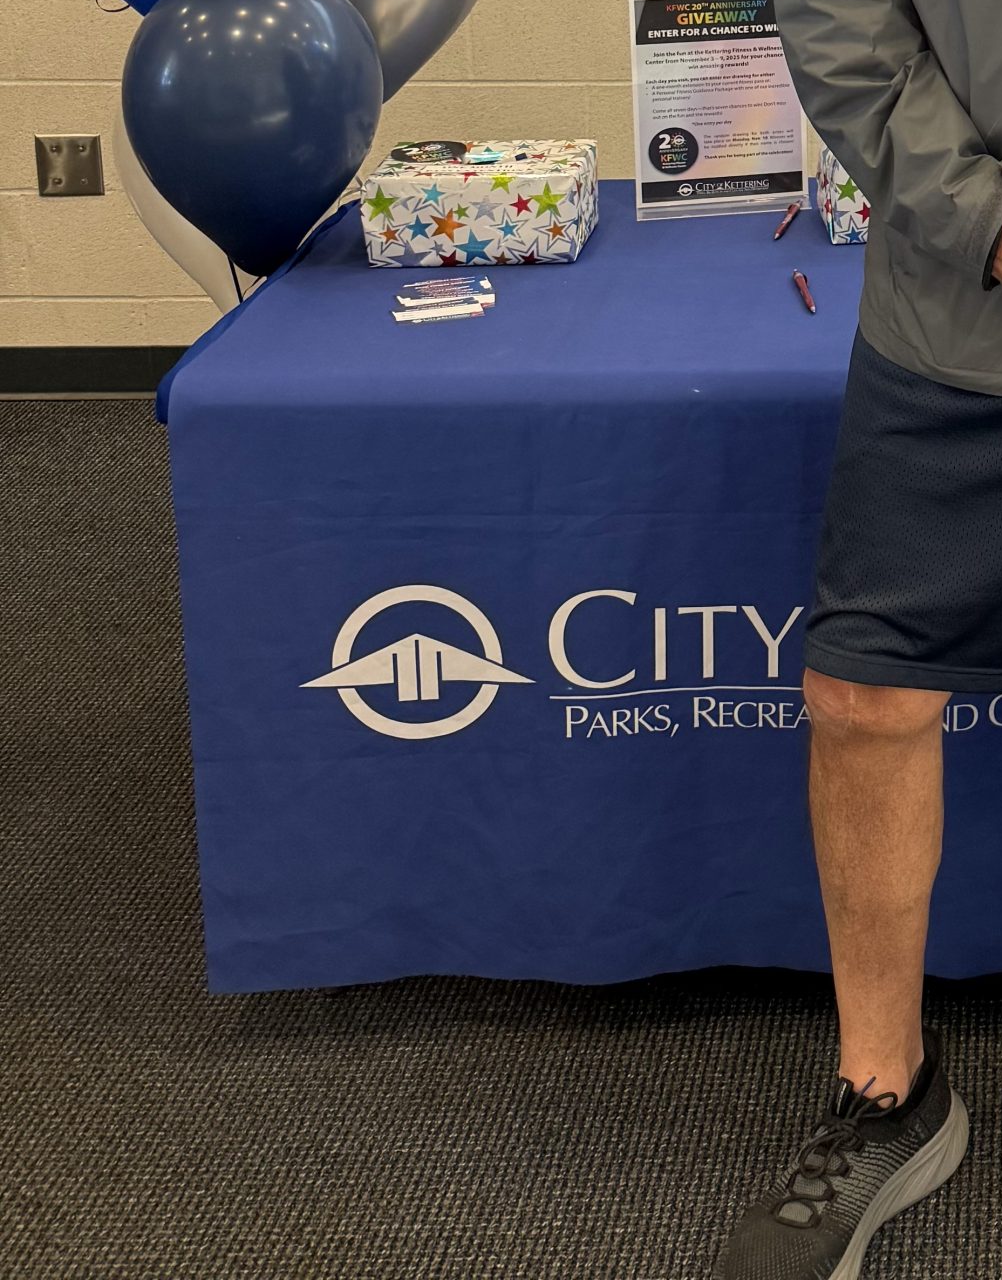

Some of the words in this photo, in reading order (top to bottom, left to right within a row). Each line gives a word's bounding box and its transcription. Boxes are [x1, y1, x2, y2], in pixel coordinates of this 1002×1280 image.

[666, 3, 690, 12] KFWC
[710, 0, 767, 9] ANNIVERSARY
[677, 10, 758, 25] GIVEAWAY
[648, 30, 679, 38] ENTER
[681, 29, 700, 37] FOR
[702, 28, 709, 36] A
[710, 25, 749, 35] CHANCE
[750, 24, 763, 33] TO
[764, 23, 779, 32] WI
[660, 153, 688, 162] KFWC
[695, 182, 715, 191] CITY
[725, 179, 769, 190] KETTERING
[548, 589, 804, 689] CITY
[566, 704, 681, 738] PARKS,
[693, 696, 812, 729] RECREA
